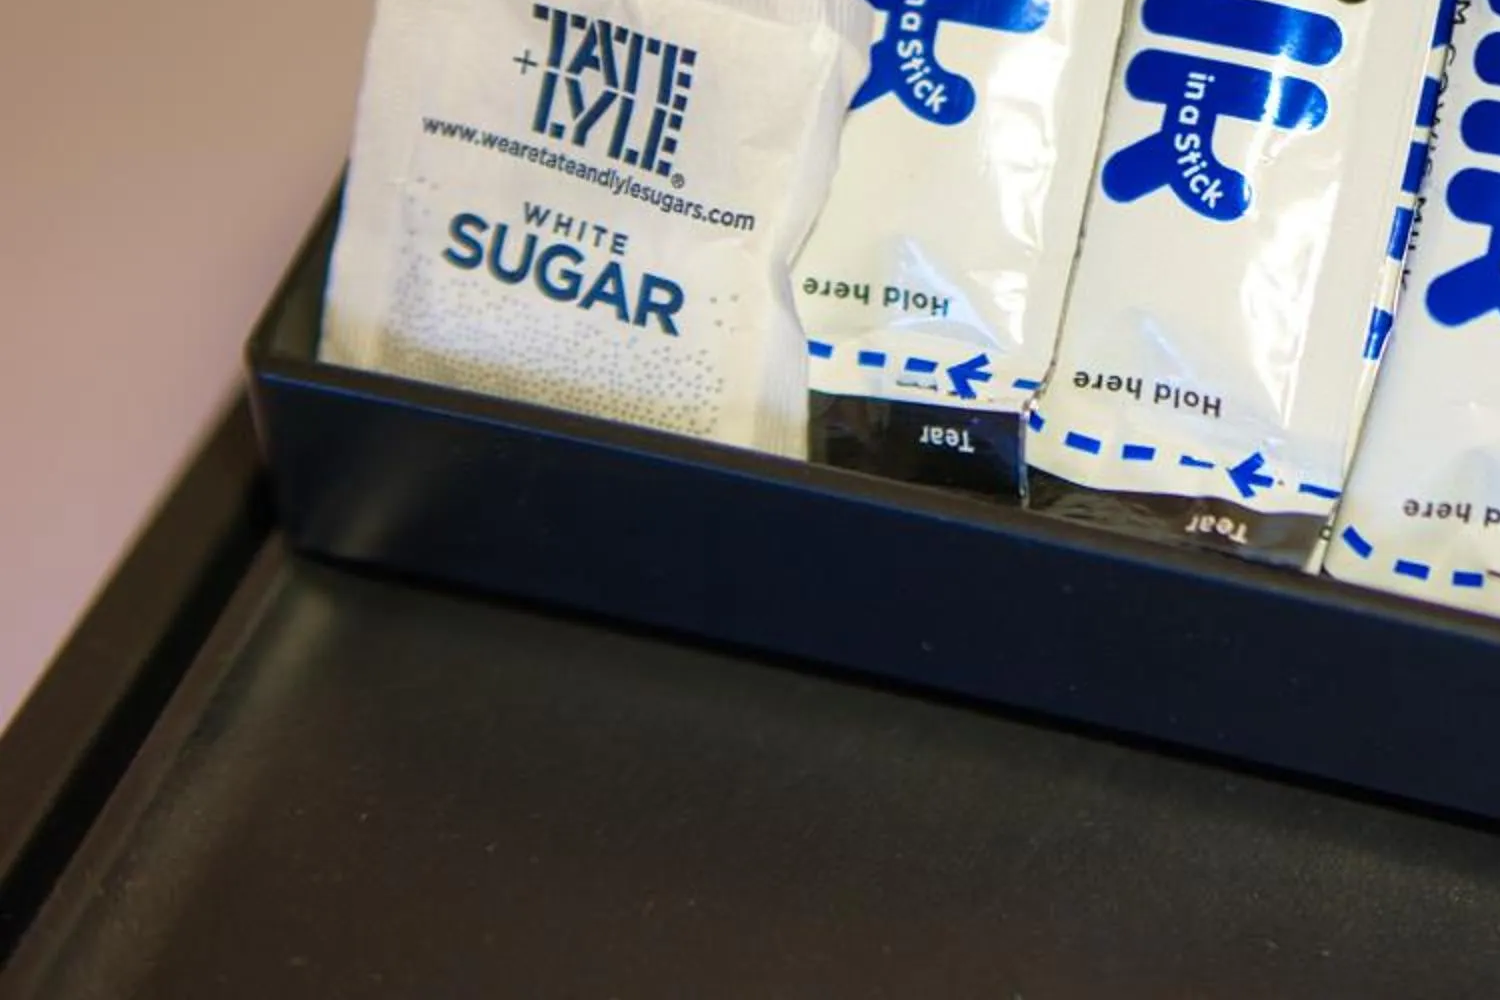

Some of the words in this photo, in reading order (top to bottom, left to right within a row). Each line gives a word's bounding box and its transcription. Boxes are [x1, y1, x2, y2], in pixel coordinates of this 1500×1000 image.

[900, 11, 922, 32] a
[533, 3, 697, 112] TATE
[1184, 72, 1215, 100] in
[1178, 104, 1200, 125] a
[421, 116, 756, 231] www.wearetateandlylesugars.com
[523, 201, 630, 255] WHITE
[443, 213, 686, 336] SUGAR
[803, 277, 870, 305] here
[883, 286, 949, 317] Hold
[1073, 370, 1142, 399] here
[1153, 383, 1222, 418] Hold
[919, 424, 975, 453] Tear
[1403, 498, 1471, 523] here
[1185, 513, 1248, 544] Tear
